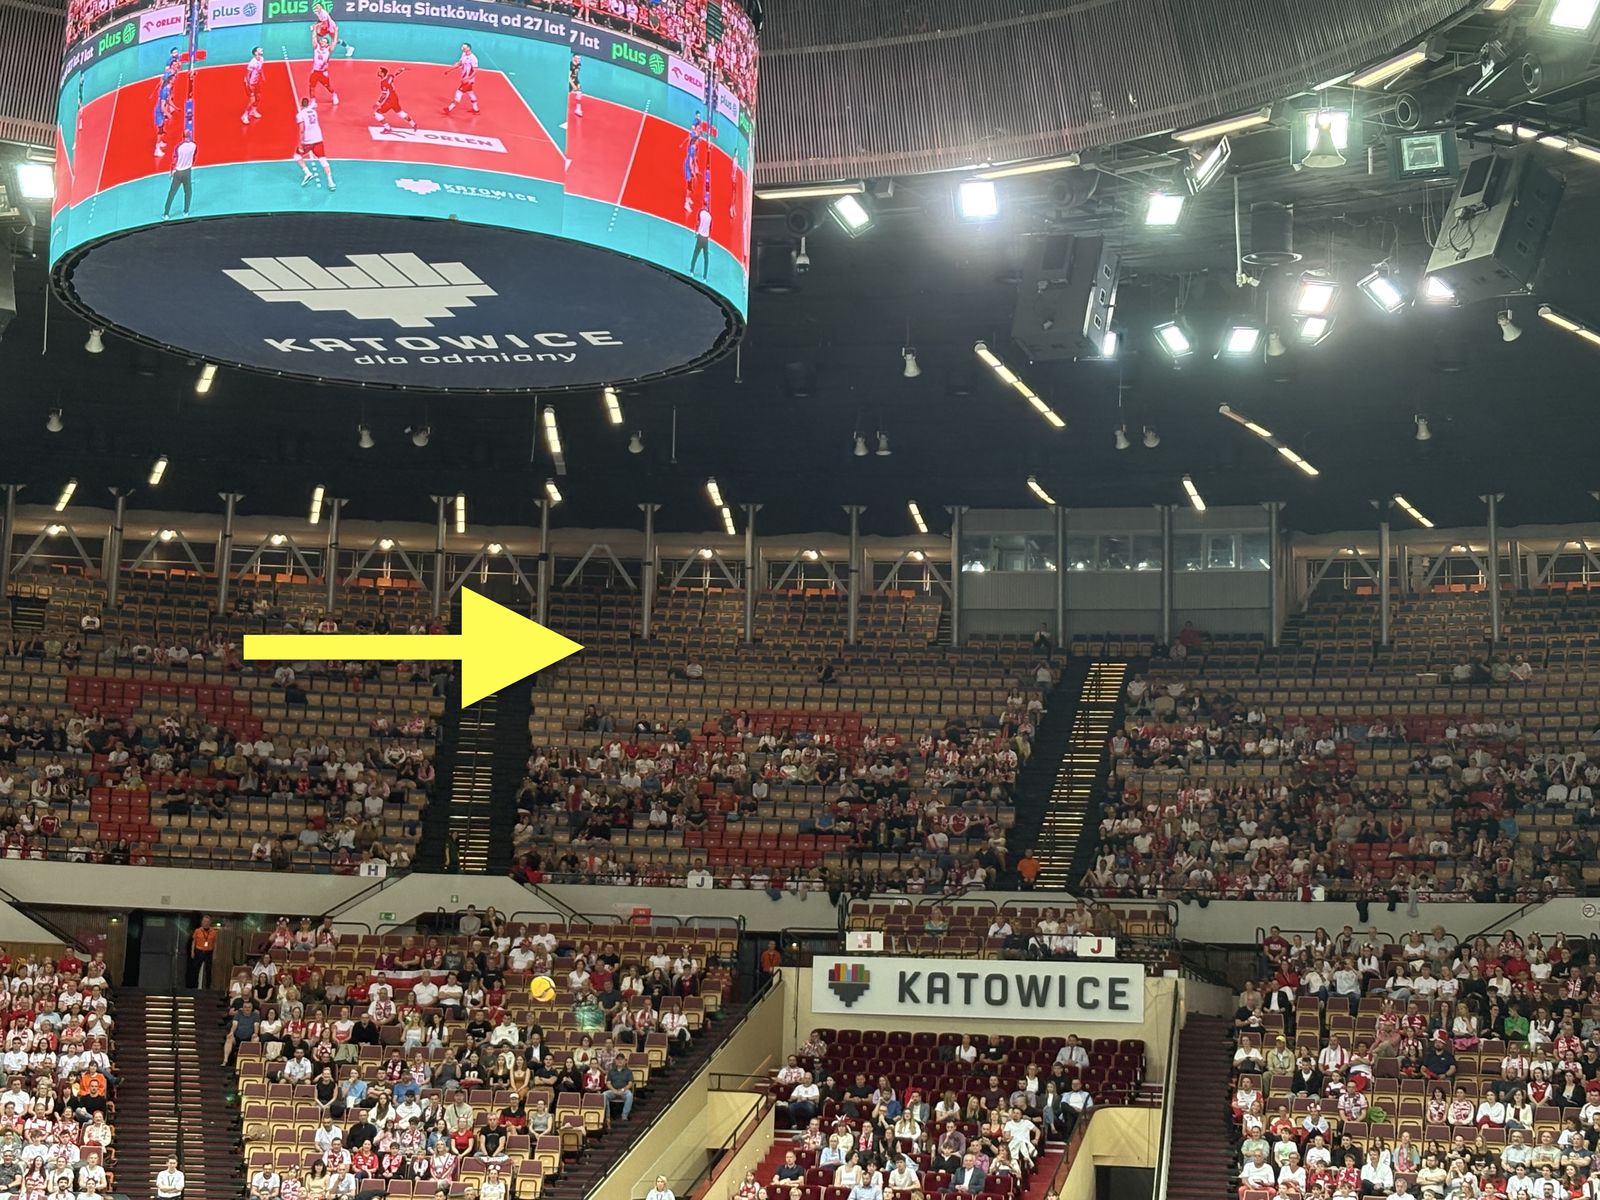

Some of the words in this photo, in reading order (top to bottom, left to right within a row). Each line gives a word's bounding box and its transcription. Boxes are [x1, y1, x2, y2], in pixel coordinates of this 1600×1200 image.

[212, 6, 240, 20] plus
[268, 0, 308, 18] plus
[156, 17, 181, 28] ORLEN
[346, 2, 355, 12] z
[358, 0, 412, 17] Polską
[414, 1, 499, 27] Siatkówką
[501, 13, 521, 28] od
[524, 17, 542, 31] 27
[545, 17, 566, 36] lat
[570, 30, 578, 42] 7
[579, 32, 600, 50] lat
[98, 31, 121, 56] plus
[611, 42, 647, 65] plus
[423, 134, 493, 147] ORLEN
[443, 183, 538, 203] KATOWICE
[264, 331, 623, 352] KATOWICE
[354, 354, 408, 365] dla
[419, 352, 577, 364] odmiany
[368, 865, 378, 876] H
[696, 877, 705, 888] J
[1090, 939, 1102, 954] J
[899, 971, 1129, 1010] KATOWICE
